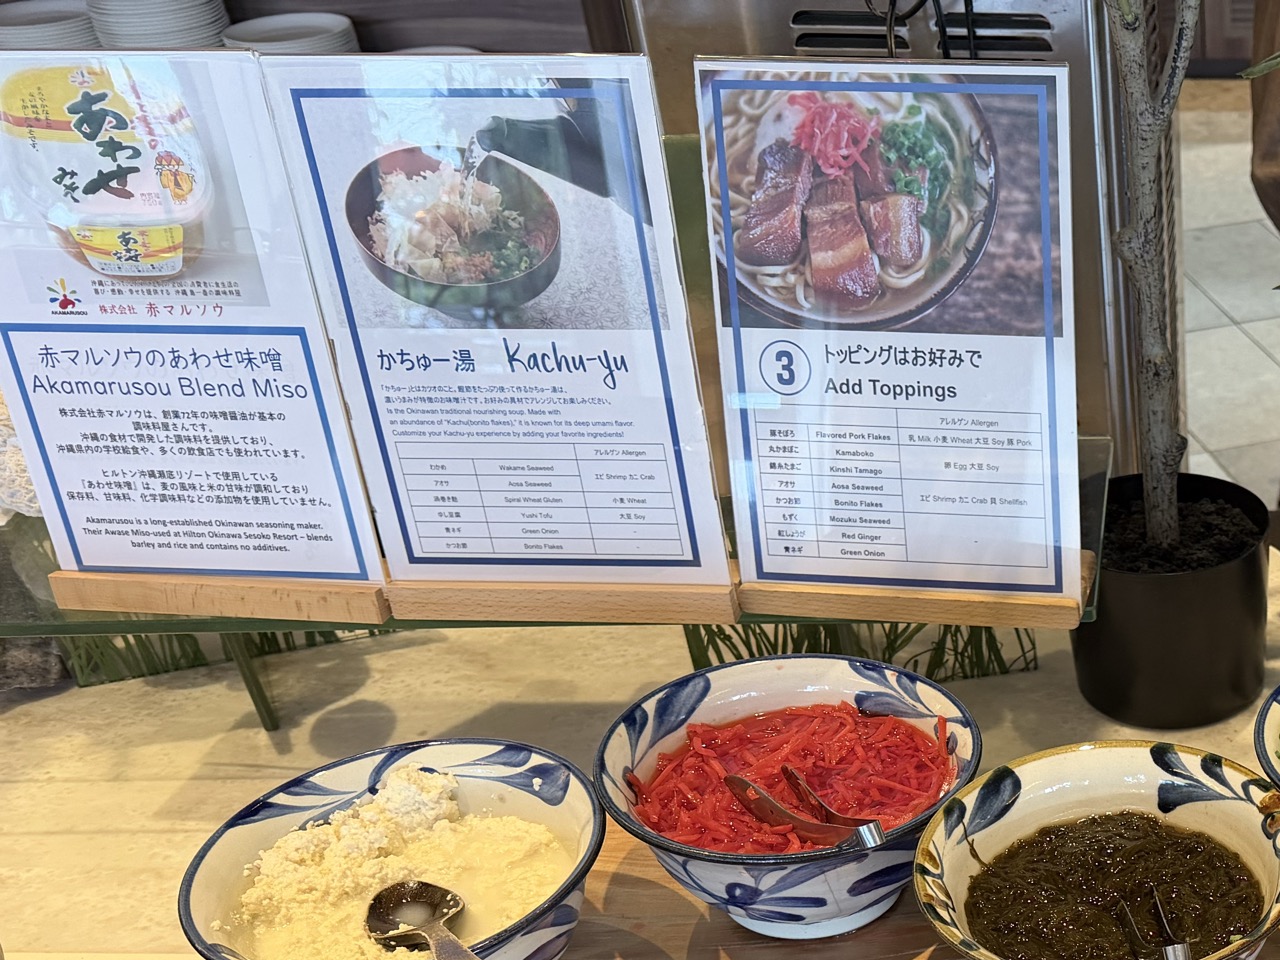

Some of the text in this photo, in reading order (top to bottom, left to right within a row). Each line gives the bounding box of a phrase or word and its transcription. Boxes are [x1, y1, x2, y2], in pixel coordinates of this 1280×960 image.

[66, 91, 142, 200] あわせ
[52, 166, 80, 203] みそ
[99, 302, 223, 317] 株式会社 赤マルソウ
[38, 344, 284, 373] 赤マルソウのあわせ味噌
[825, 344, 982, 369] トッピングはお好みで
[377, 337, 629, 389] かちゅー湯 Kachu-yu
[776, 350, 796, 386] 3
[32, 374, 308, 399] Akamarusou Blend Miso
[824, 377, 957, 402] Add Toppings
[406, 407, 439, 415] Okinawan
[473, 408, 507, 416] nourishing
[940, 417, 999, 428] アレルゲン Allergen
[443, 430, 474, 438] Kachu-yu
[475, 430, 511, 438] experience
[586, 431, 624, 439] ingredients!
[769, 429, 891, 441] 豚そぼろ Flavored Pork Flakes
[917, 435, 931, 443] Milk
[933, 435, 949, 444] 小麦
[950, 436, 973, 444] Wheat
[974, 437, 990, 445] 大豆
[991, 438, 1005, 447] Soy
[621, 449, 646, 457] Allergen
[835, 449, 874, 457] Kamaboko
[829, 465, 853, 473] Kinshi
[854, 466, 883, 476] Tamago
[953, 462, 967, 471] Egg
[969, 462, 984, 471] 大豆
[986, 463, 1000, 472] Soy
[778, 480, 884, 492] アオサ Aosa Seaweed
[834, 499, 858, 507] Bonito
[859, 500, 883, 508] Flakes
[932, 495, 957, 504] Shrimp
[999, 497, 1028, 506] Shellfish
[86, 516, 134, 525] Akamarusou
[135, 517, 142, 525] is
[150, 518, 213, 527] long-established
[214, 520, 254, 528] Okinawan
[256, 521, 295, 530] seasoning
[297, 522, 323, 530] maker.
[829, 515, 857, 523] Mozuku
[859, 517, 891, 525] Seaweed
[104, 528, 130, 536] Awase
[131, 529, 171, 537] Miso-used
[183, 530, 206, 538] Hilton
[207, 531, 242, 539] Okinawa
[244, 532, 271, 540] Sesoko
[273, 533, 298, 541] Resort
[306, 533, 333, 541] blends
[857, 533, 881, 541] Ginger
[131, 540, 155, 549] barley
[157, 541, 172, 549] and
[173, 541, 188, 549] rice
[190, 542, 204, 550] and
[206, 542, 239, 550] contains
[252, 543, 290, 552] additives.
[840, 548, 862, 556] Green
[863, 549, 886, 557] Onion
